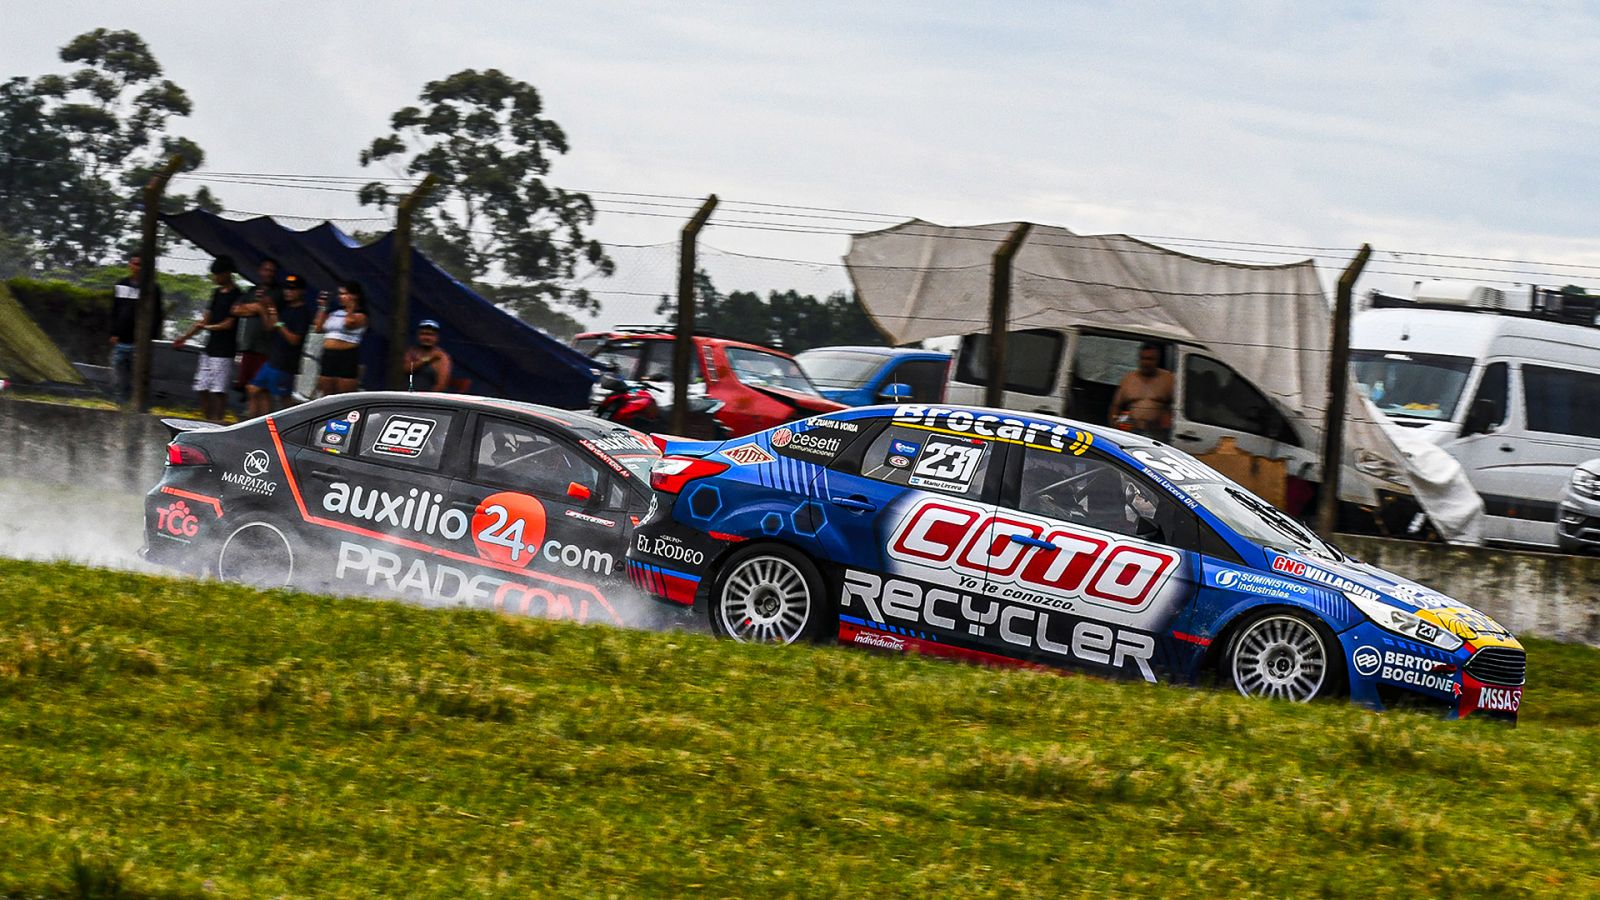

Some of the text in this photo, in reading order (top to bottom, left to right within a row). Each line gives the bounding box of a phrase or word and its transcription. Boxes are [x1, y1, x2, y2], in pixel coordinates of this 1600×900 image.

[380, 420, 431, 448] 68
[892, 404, 1070, 449] Brocart
[789, 443, 835, 458] comunicaciones
[791, 432, 842, 451] cesetti
[729, 446, 766, 463] LOTUS
[914, 441, 983, 482] 231
[221, 471, 278, 493] MARPATAG
[156, 507, 199, 537] TCG
[637, 534, 704, 565] EL RODEO
[892, 502, 1174, 606] COTO
[958, 576, 1076, 612] Yo te conozco.
[1237, 581, 1290, 599] Industriales
[1240, 572, 1309, 595] SUMINISTROS
[854, 633, 904, 650] individuales
[1419, 624, 1437, 639] 231
[1381, 666, 1454, 693] BOGLIONE
